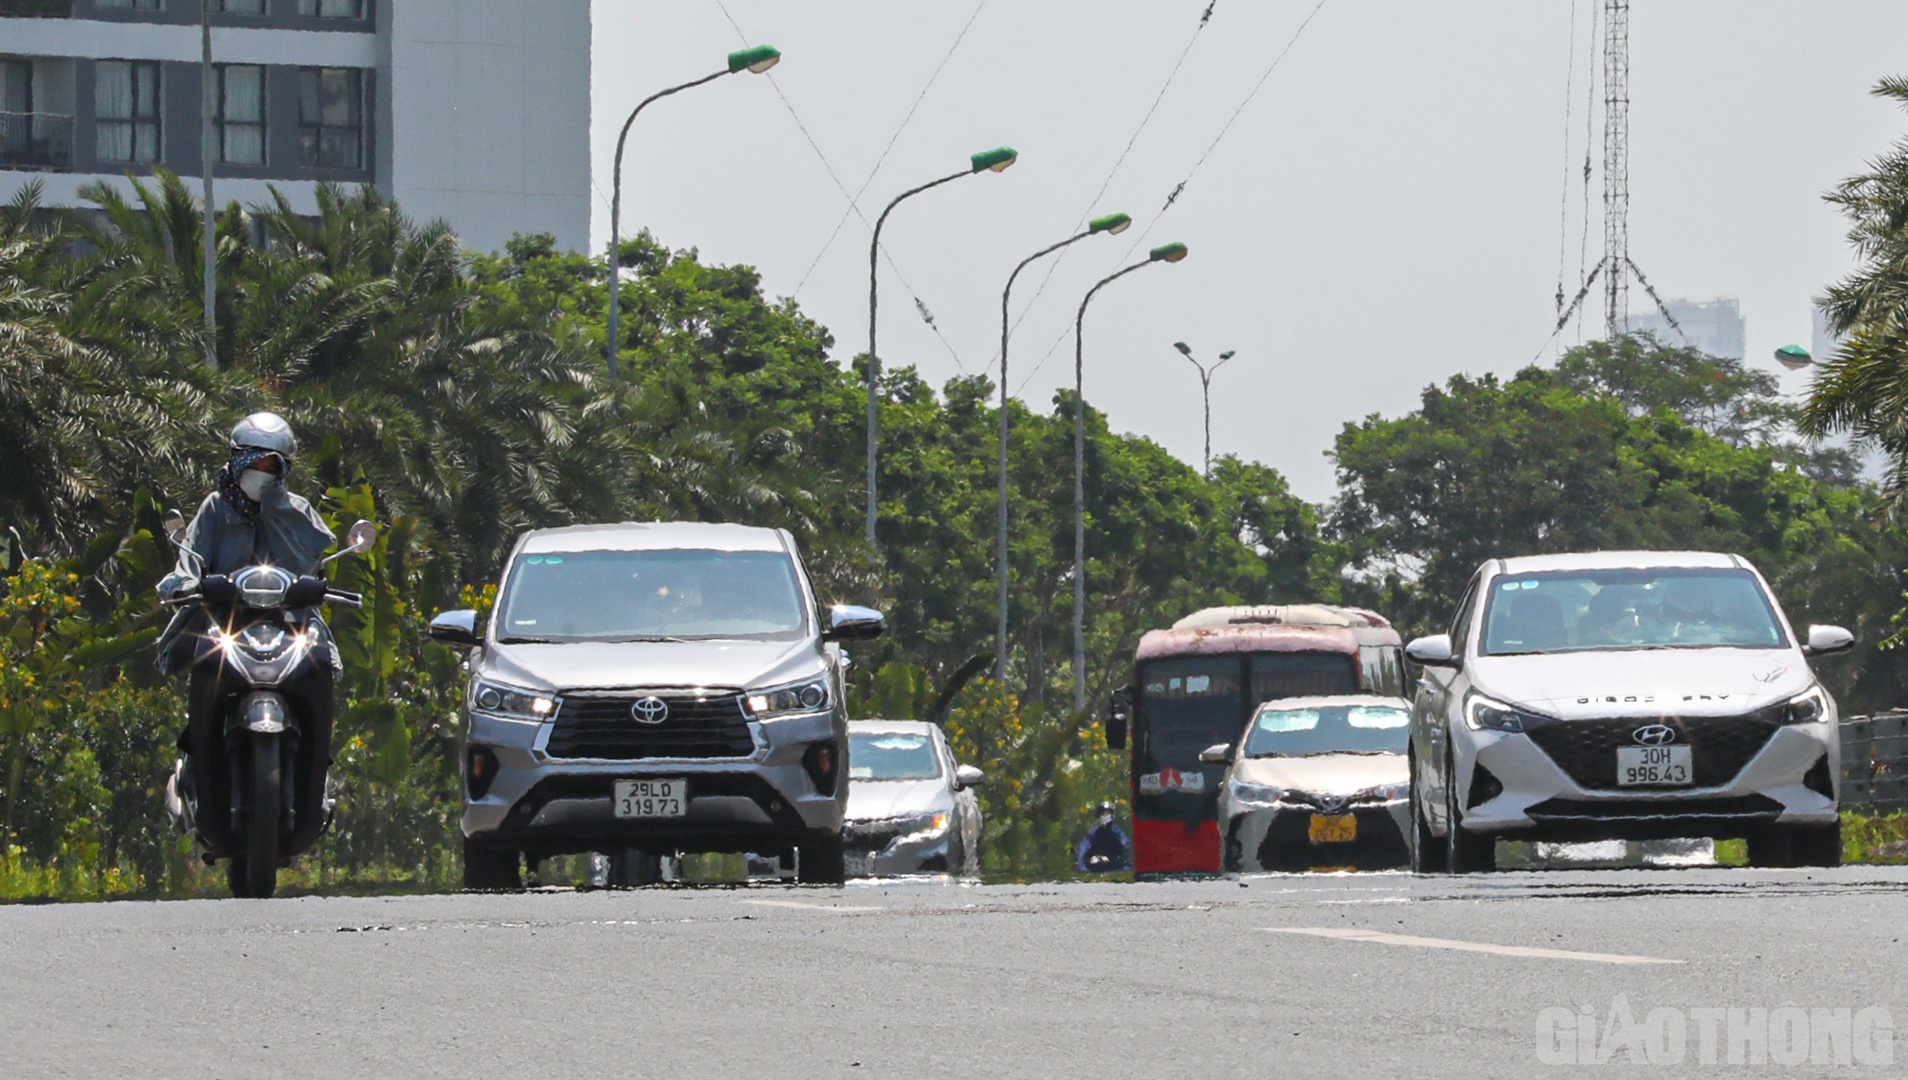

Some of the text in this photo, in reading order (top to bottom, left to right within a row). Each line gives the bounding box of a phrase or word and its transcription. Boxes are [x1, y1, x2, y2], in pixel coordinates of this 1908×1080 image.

[1640, 748, 1671, 764] 30H
[1627, 765, 1686, 783] 996.43
[628, 783, 671, 797] 29LD
